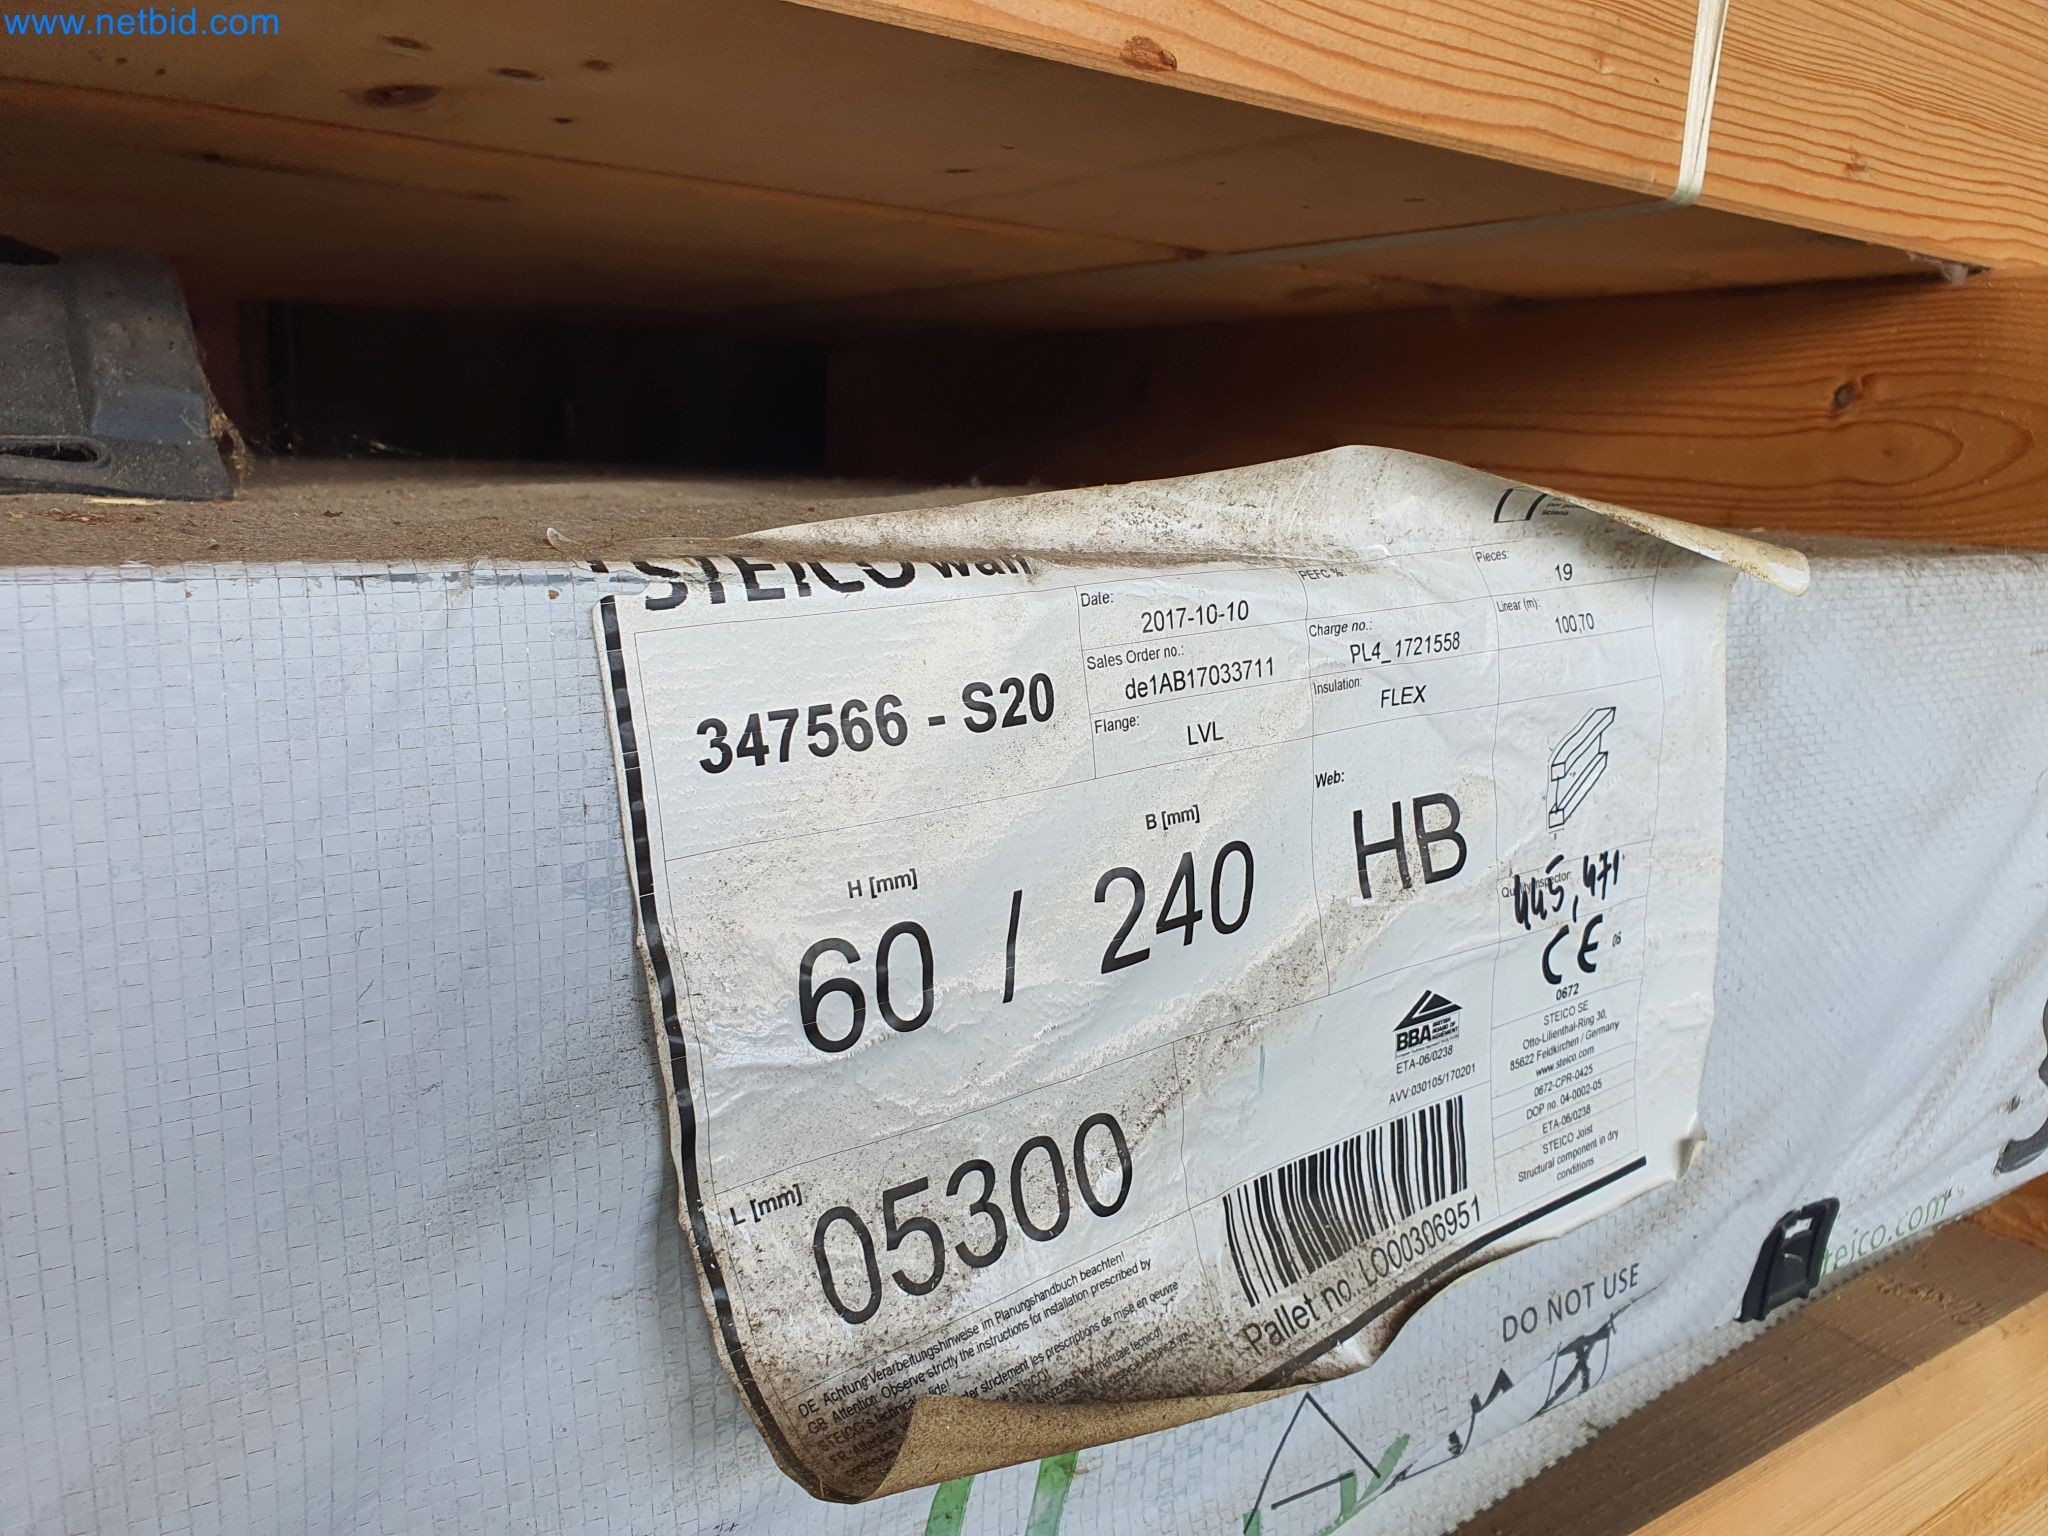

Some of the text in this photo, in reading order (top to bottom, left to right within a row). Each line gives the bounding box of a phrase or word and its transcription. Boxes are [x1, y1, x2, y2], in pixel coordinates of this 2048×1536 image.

[1475, 550, 1509, 563] Pieces:
[1555, 563, 1573, 581] 19
[1298, 568, 1330, 581] PEFC
[1081, 591, 1114, 607] Date:
[1497, 597, 1541, 613] Linear (m):
[1141, 600, 1249, 634] 2017-10-10
[1309, 620, 1372, 637] Charge no.:
[1555, 613, 1594, 634] 100,70
[1087, 644, 1184, 670] Sales Order no.:
[1125, 656, 1274, 700] de1AB17033711
[1313, 677, 1362, 695] Insulation:
[1381, 685, 1427, 708] FLEX
[697, 673, 1055, 774] 347566 - S20
[1095, 716, 1140, 734] Flange:
[1187, 721, 1224, 746] LVL
[1315, 770, 1345, 789] Web:
[1145, 804, 1200, 830] B [mm]
[1353, 792, 1467, 899] HB
[847, 868, 919, 899] H [mm]
[799, 840, 1254, 1053] 60 / 240
[1542, 914, 1603, 984] CE
[1556, 983, 1579, 1000] 0672
[1543, 1000, 1589, 1026] STEICO SE
[1396, 1024, 1431, 1052] BBA
[1510, 1053, 1534, 1071] 85622
[1536, 1037, 1579, 1061] Feldkirchen
[1585, 1020, 1620, 1040] Germany
[1522, 1014, 1594, 1050] Otto-Lilienthal-Ring
[1396, 1045, 1453, 1074] ETA-06/0238
[1536, 1045, 1594, 1077] www.steico.com
[1389, 1063, 1476, 1105] AVV:030105/170201
[1534, 1064, 1594, 1097] 0672-CPR-0425
[1526, 1079, 1603, 1120] DOP no. 04-0002-05
[1542, 1104, 1591, 1134] ETA-06/0238
[1542, 1124, 1594, 1154] STEICO Joist
[1518, 1129, 1619, 1183] Structural component in dry
[1557, 1157, 1594, 1181] conditions
[729, 1183, 804, 1227] L [mm]
[812, 1112, 1133, 1325] 05300
[1820, 1190, 1950, 1275] teico.com
[1502, 1262, 1639, 1343] DO NOT USE
[798, 1399, 820, 1418] DE
[867, 1324, 980, 1384] Verarbeitungshinweise
[982, 1318, 994, 1332] im
[994, 1273, 1079, 1325] Planungshandbuch
[1079, 1251, 1126, 1282] beachten!
[1243, 1292, 1320, 1356] Pallet
[808, 1258, 1151, 1434] GB Attention: Observe strictly the instructions for installation prescribed by
[981, 1359, 1030, 1394] strictement
[1031, 1351, 1045, 1367] les
[1047, 1322, 1100, 1361] prescriptions
[1101, 1313, 1112, 1327] de
[1137, 1296, 1148, 1309] en
